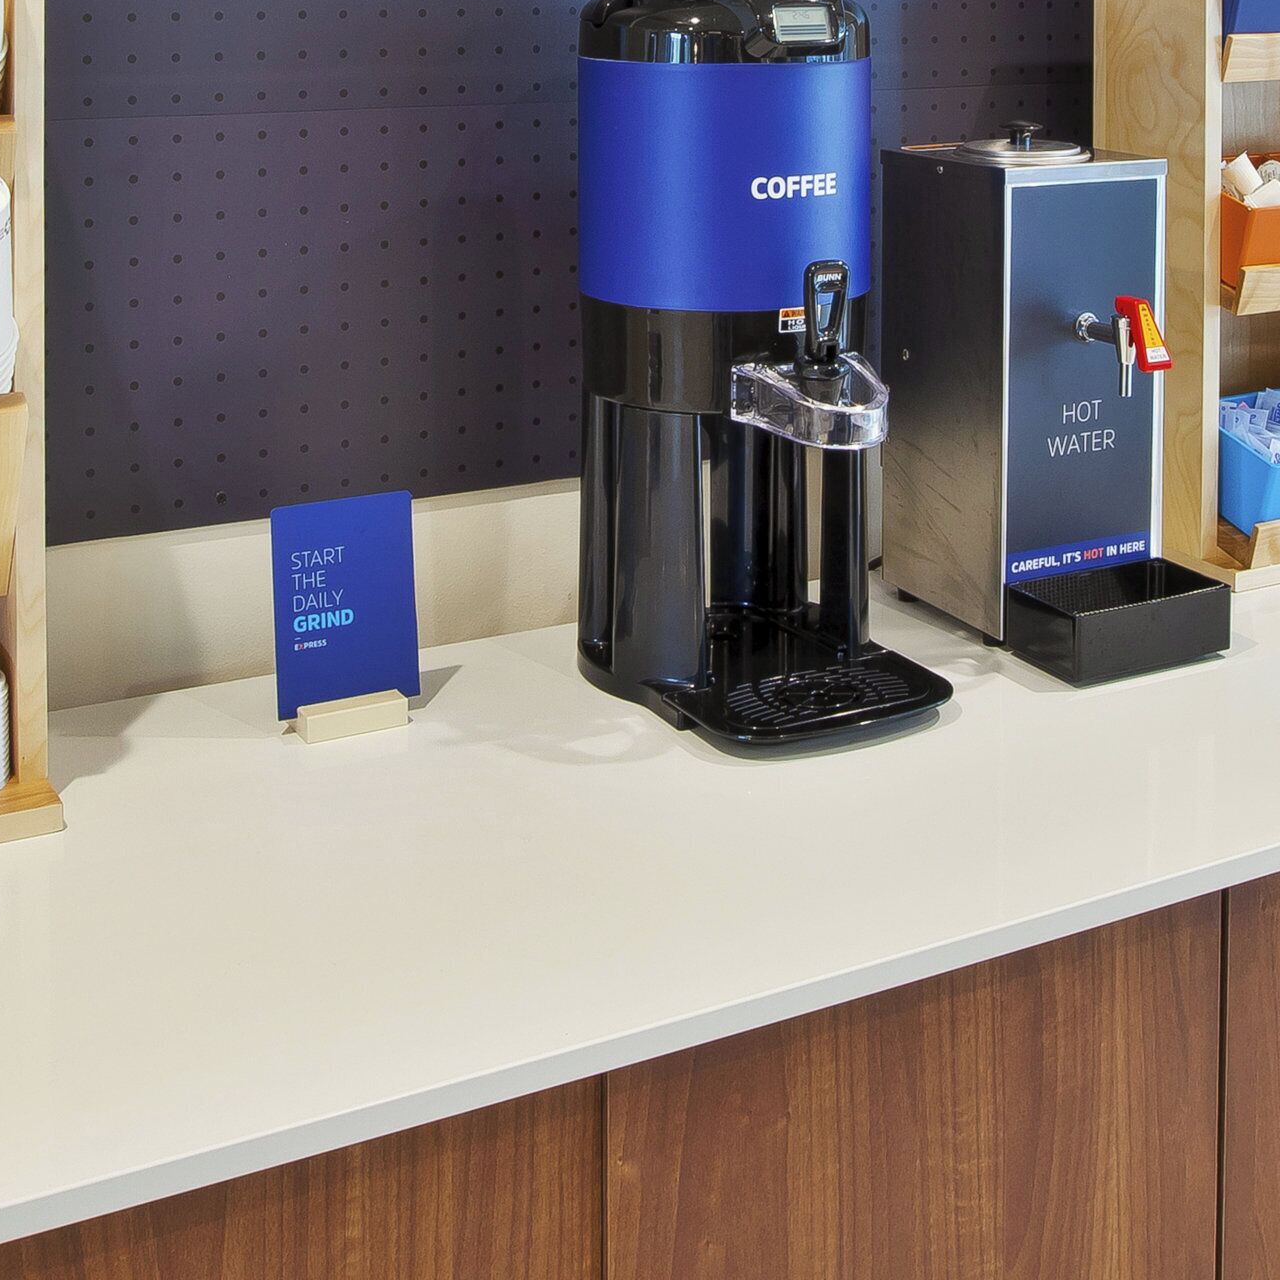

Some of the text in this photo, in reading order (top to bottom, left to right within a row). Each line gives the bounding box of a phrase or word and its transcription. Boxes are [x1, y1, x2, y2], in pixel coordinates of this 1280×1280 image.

[750, 172, 838, 200] COFFEE
[1063, 400, 1102, 424] HOT
[1047, 429, 1116, 457] WATER
[291, 546, 345, 570] START
[1011, 540, 1146, 573] CAREFUL, IT'S HOT IN HERE
[291, 570, 327, 590] THE
[293, 589, 344, 613] DAILY
[293, 608, 354, 633] GRIND
[294, 639, 327, 651] EXPRESS
